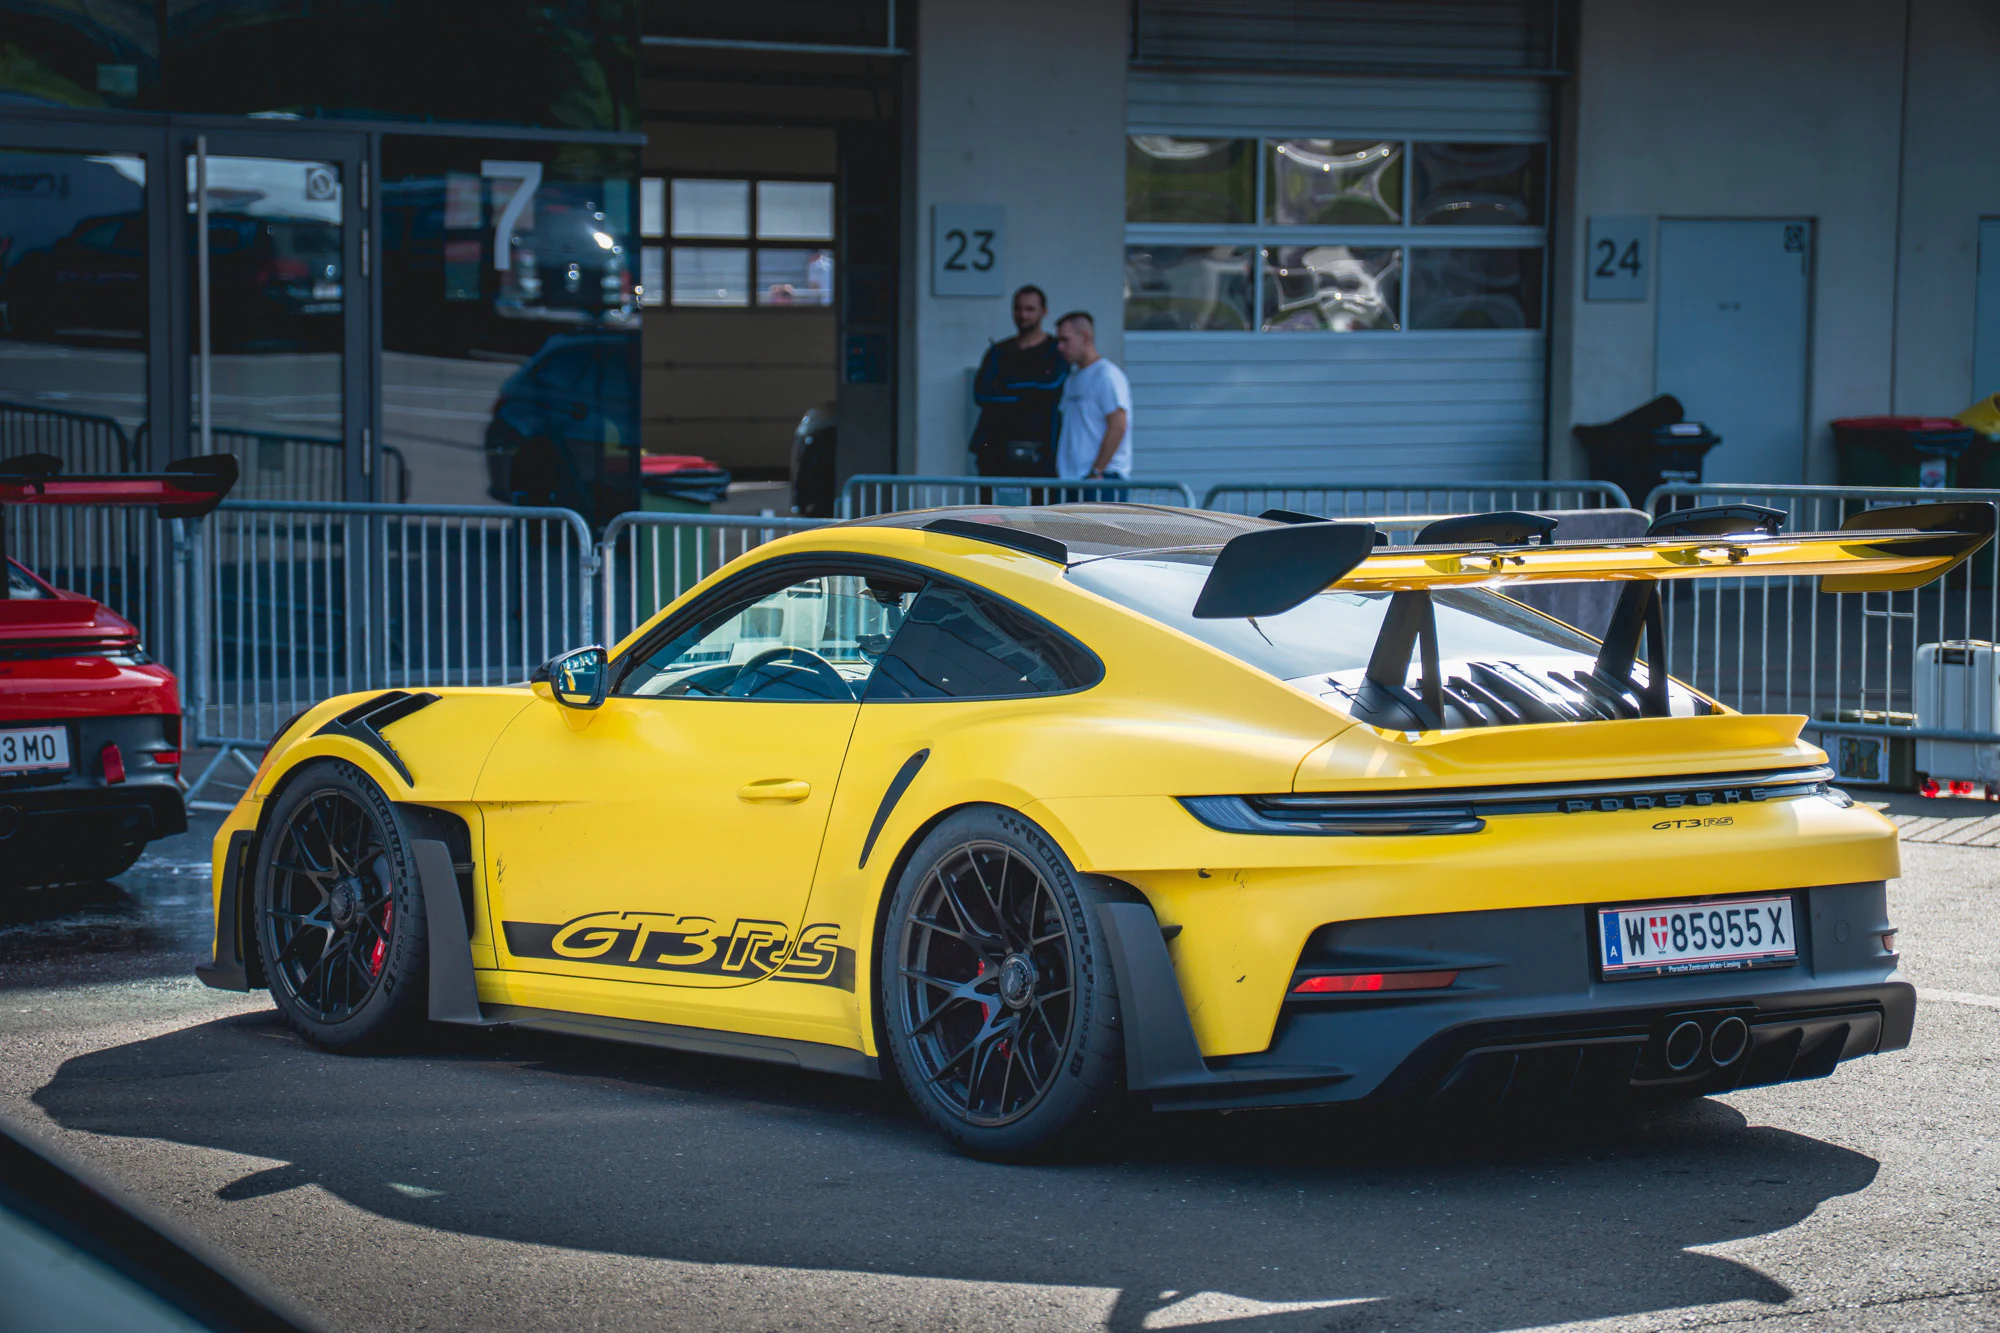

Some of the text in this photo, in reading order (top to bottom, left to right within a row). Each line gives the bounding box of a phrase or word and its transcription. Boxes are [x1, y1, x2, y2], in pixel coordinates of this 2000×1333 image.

[481, 160, 543, 270] 7
[944, 228, 996, 272] 23
[1595, 238, 1642, 278] 24
[23, 734, 56, 762] MO
[1566, 788, 1767, 812] PORSCHE
[368, 788, 404, 863] MICHELIN
[1040, 844, 1085, 929] MICHELIN
[1609, 945, 1619, 958] A
[1624, 906, 1786, 956] W 85955 X
[1668, 964, 1689, 973] Porsche
[1688, 962, 1710, 972] Zentrum
